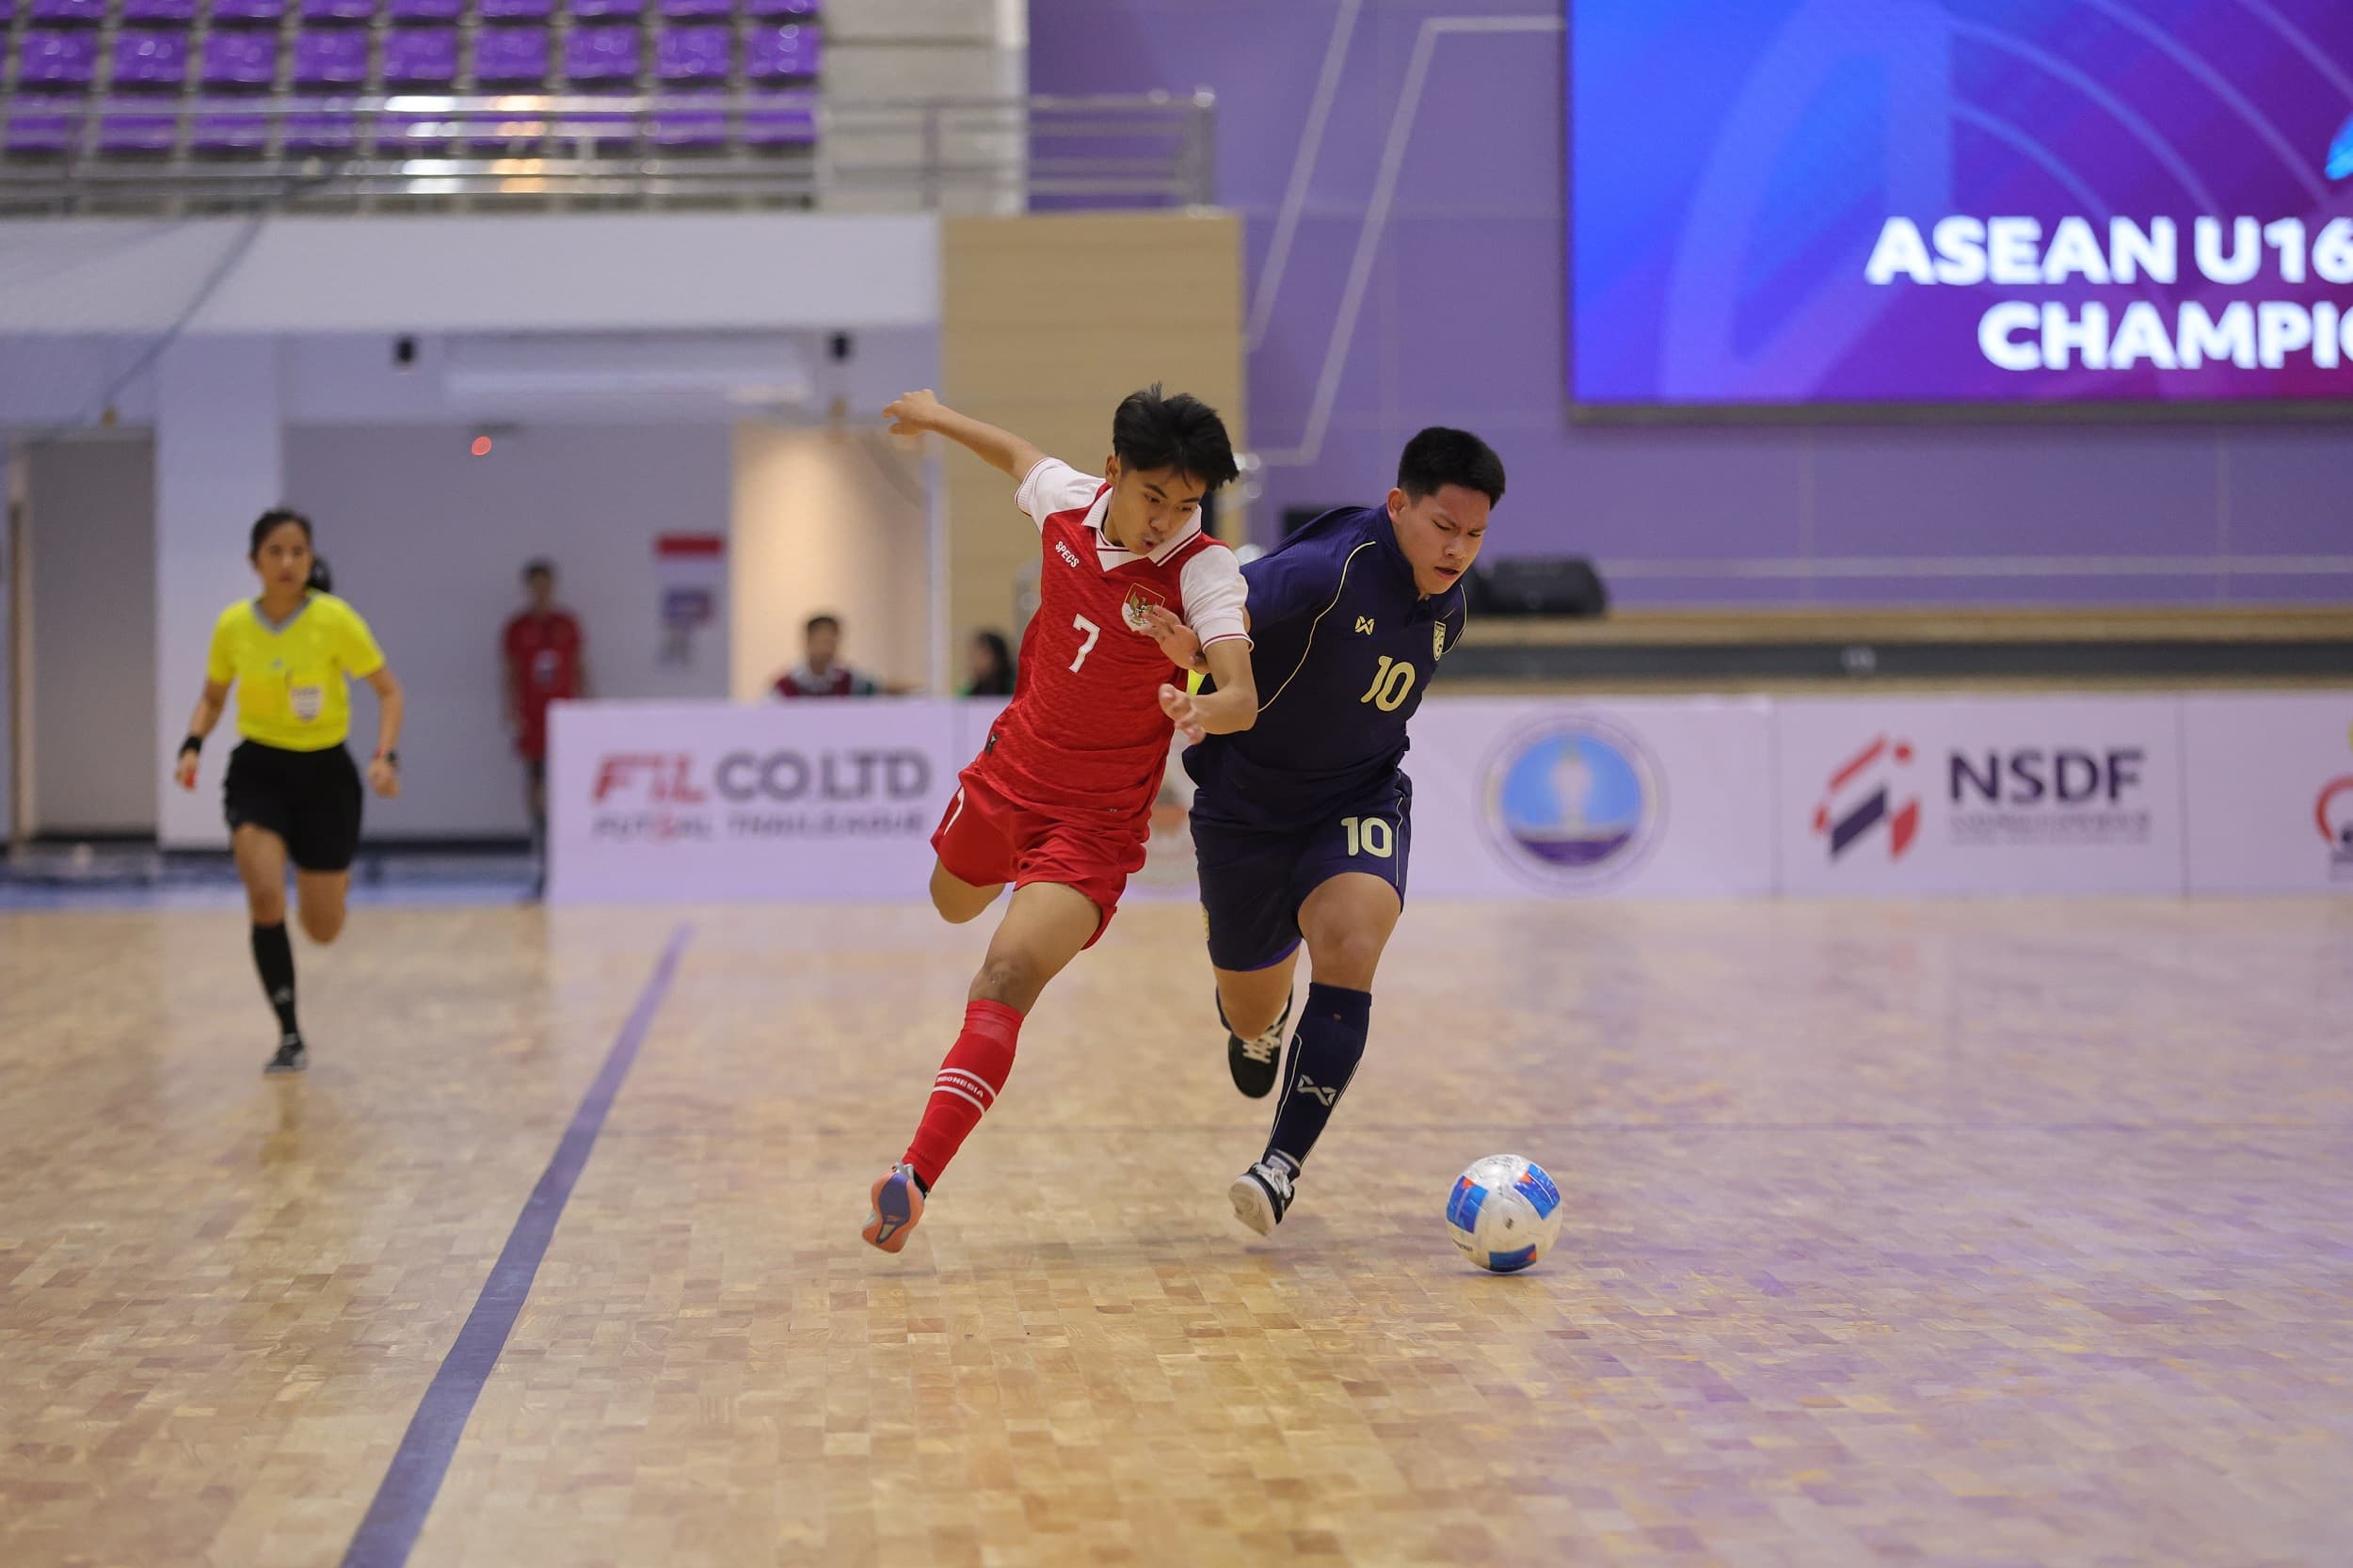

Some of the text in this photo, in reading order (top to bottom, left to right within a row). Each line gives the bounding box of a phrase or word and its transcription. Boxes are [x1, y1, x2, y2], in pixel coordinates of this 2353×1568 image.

[1865, 216, 2353, 285] ASEAN U16
[1977, 300, 2353, 371] CHAMPI
[1055, 540, 1080, 568] SPECS
[1069, 614, 1101, 673] 7
[1361, 655, 1416, 712] 10
[1947, 748, 2145, 804] NSDF
[1340, 816, 1393, 858] 10
